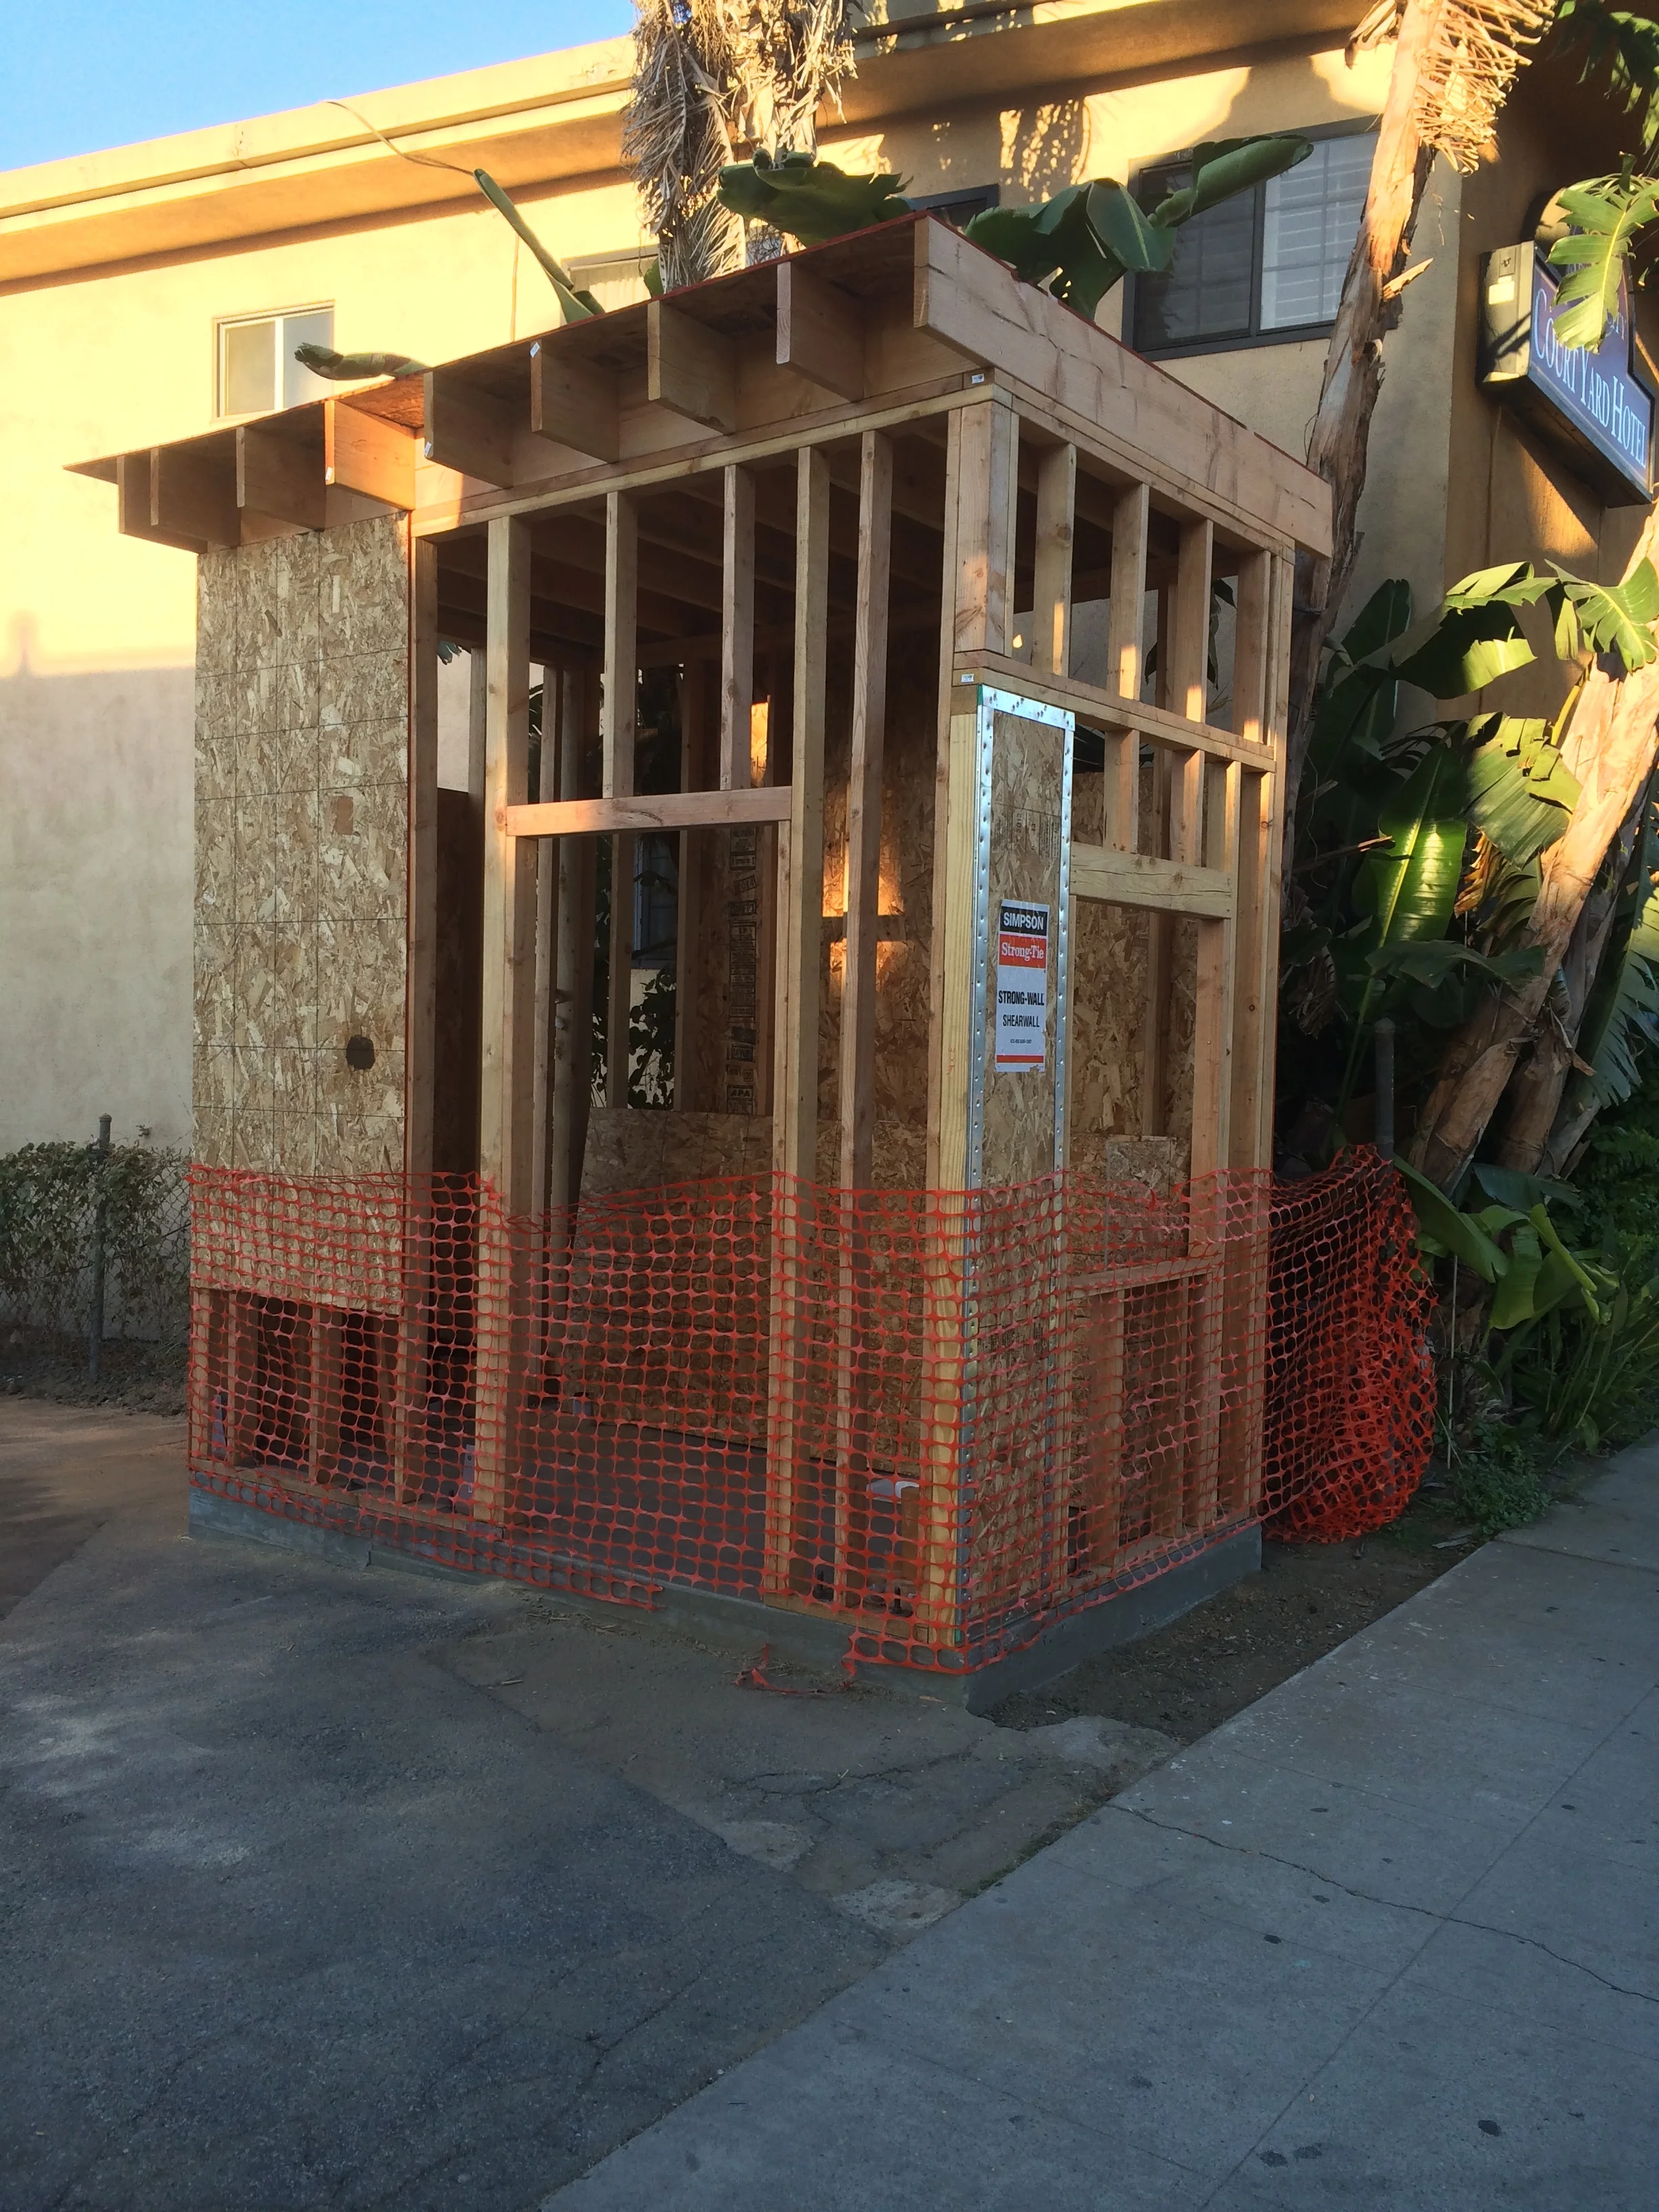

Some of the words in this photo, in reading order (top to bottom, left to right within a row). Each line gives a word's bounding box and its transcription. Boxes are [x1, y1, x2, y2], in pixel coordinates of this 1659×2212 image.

[1610, 375, 1647, 469] HOTEL
[1003, 912, 1044, 930] SIMPSON
[1002, 941, 1044, 962] Strong-Tie
[998, 990, 1045, 1006] STRONG-WALL
[1002, 1014, 1040, 1027] SHEARWALL
